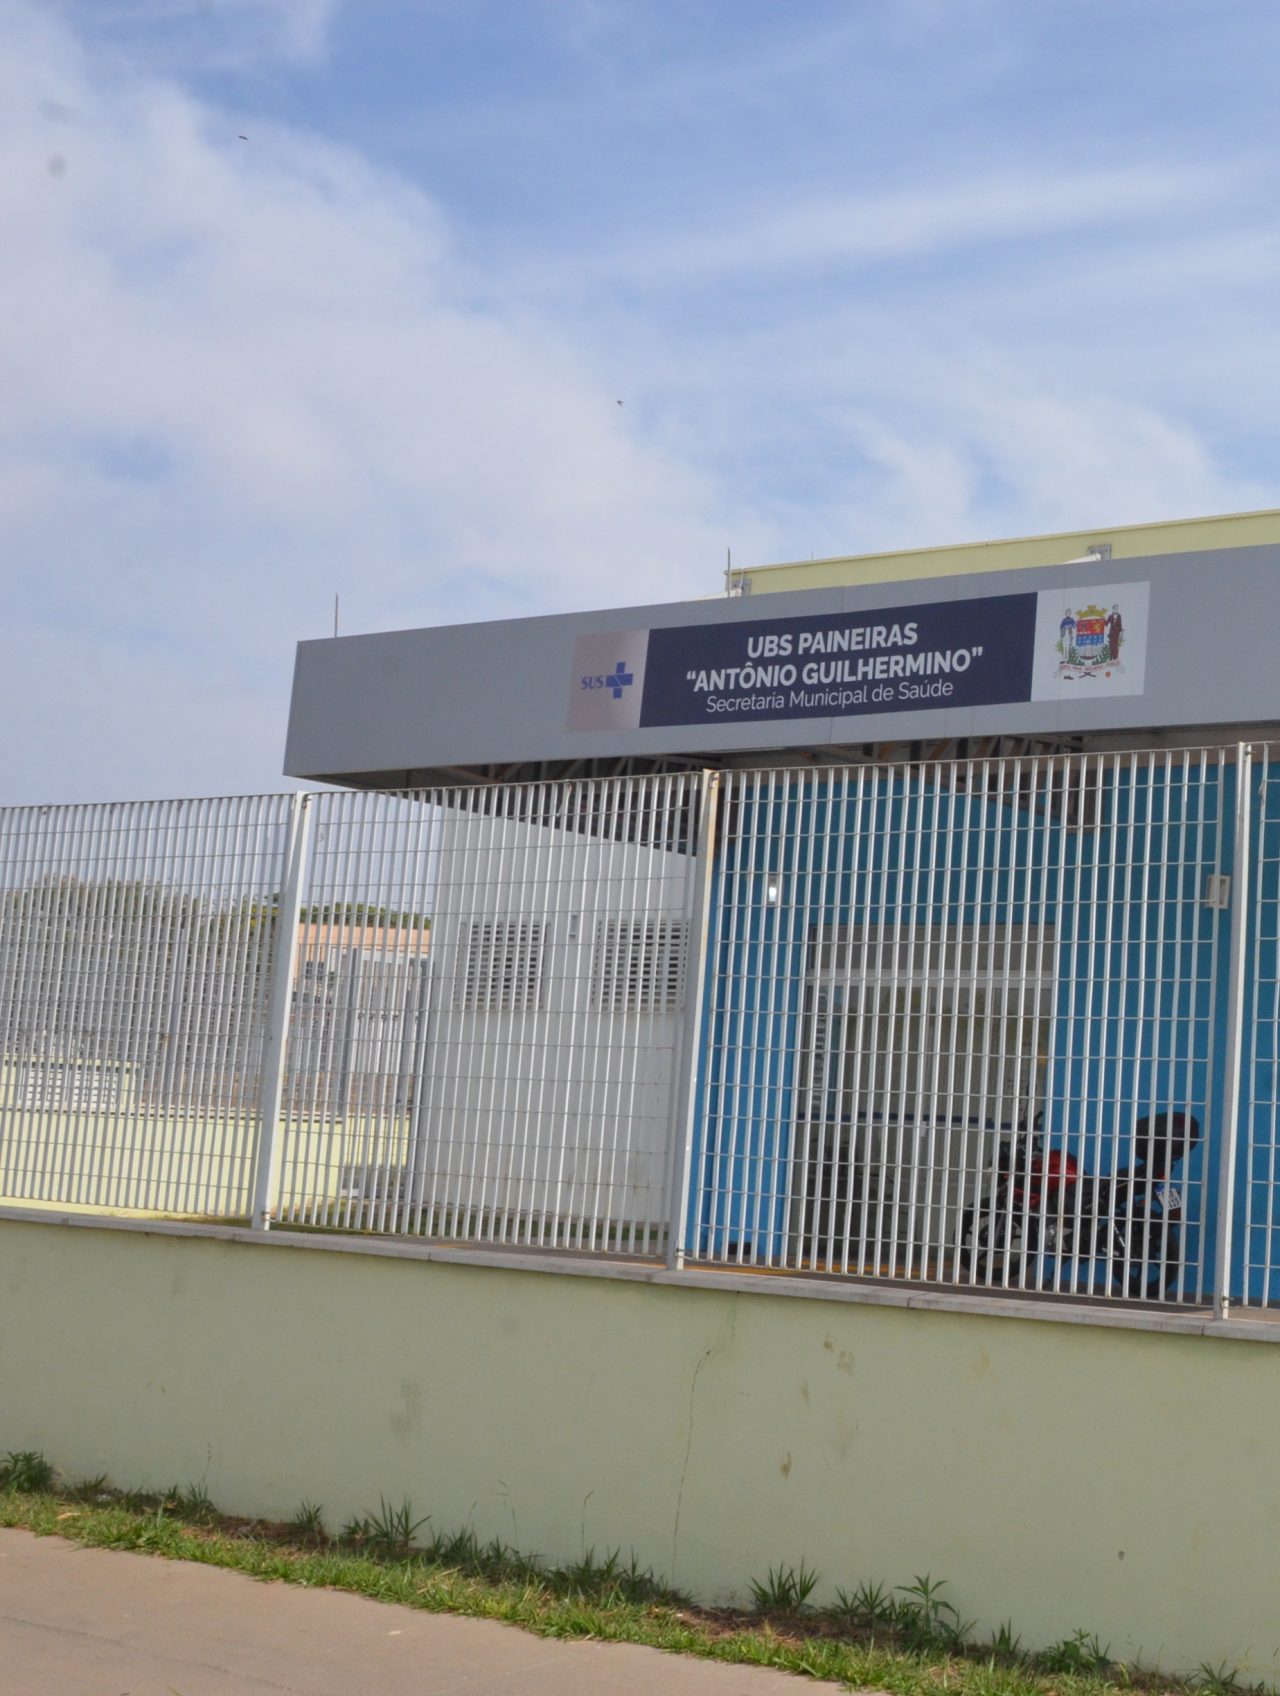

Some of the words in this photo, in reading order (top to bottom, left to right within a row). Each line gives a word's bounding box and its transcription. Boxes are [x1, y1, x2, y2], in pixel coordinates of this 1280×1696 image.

[747, 633, 793, 658] UBS
[797, 622, 918, 655] PAINEIRAS
[580, 675, 605, 690] SUS
[706, 692, 785, 713] Secretaria
[789, 685, 867, 709] Municipal
[871, 683, 895, 702] de
[898, 679, 954, 700] Saúde
